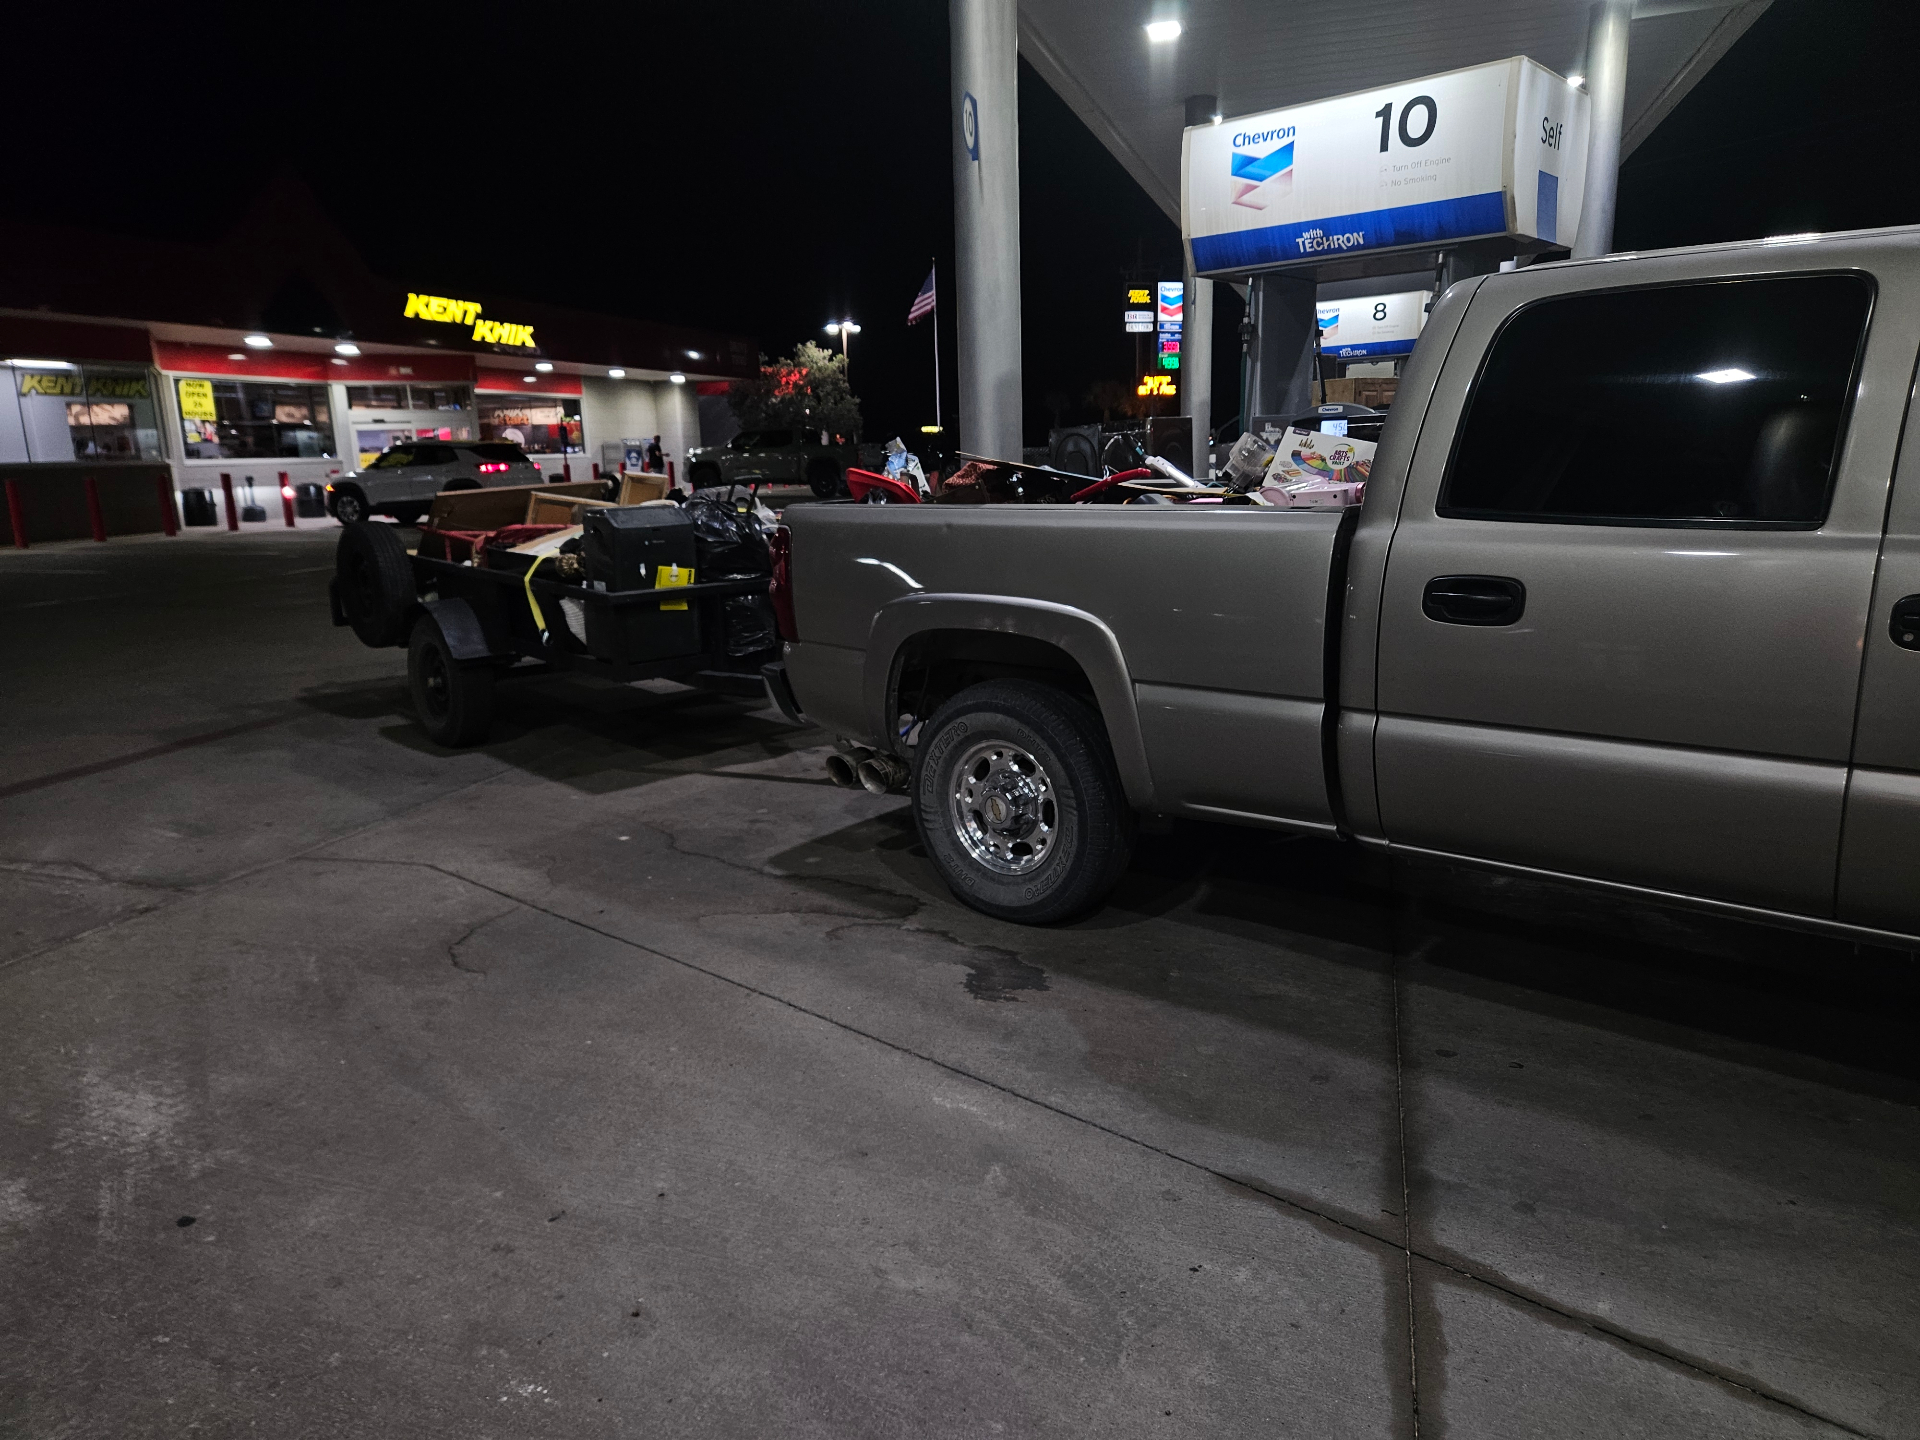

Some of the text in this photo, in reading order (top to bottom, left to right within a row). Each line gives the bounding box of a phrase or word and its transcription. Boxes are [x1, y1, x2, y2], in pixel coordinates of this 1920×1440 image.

[965, 107, 974, 138] 10
[1374, 95, 1438, 153] 10
[1541, 116, 1563, 151] Self
[1232, 125, 1296, 149] Chevron
[1392, 157, 1452, 173] Turn Off Engine
[1390, 174, 1438, 188] No Smoking
[1295, 231, 1364, 253] TECHRON
[1302, 228, 1323, 239] with
[403, 292, 482, 326] KENT
[1373, 302, 1387, 321] 8
[472, 319, 536, 348] KWIK
[185, 391, 208, 399] OPEN
